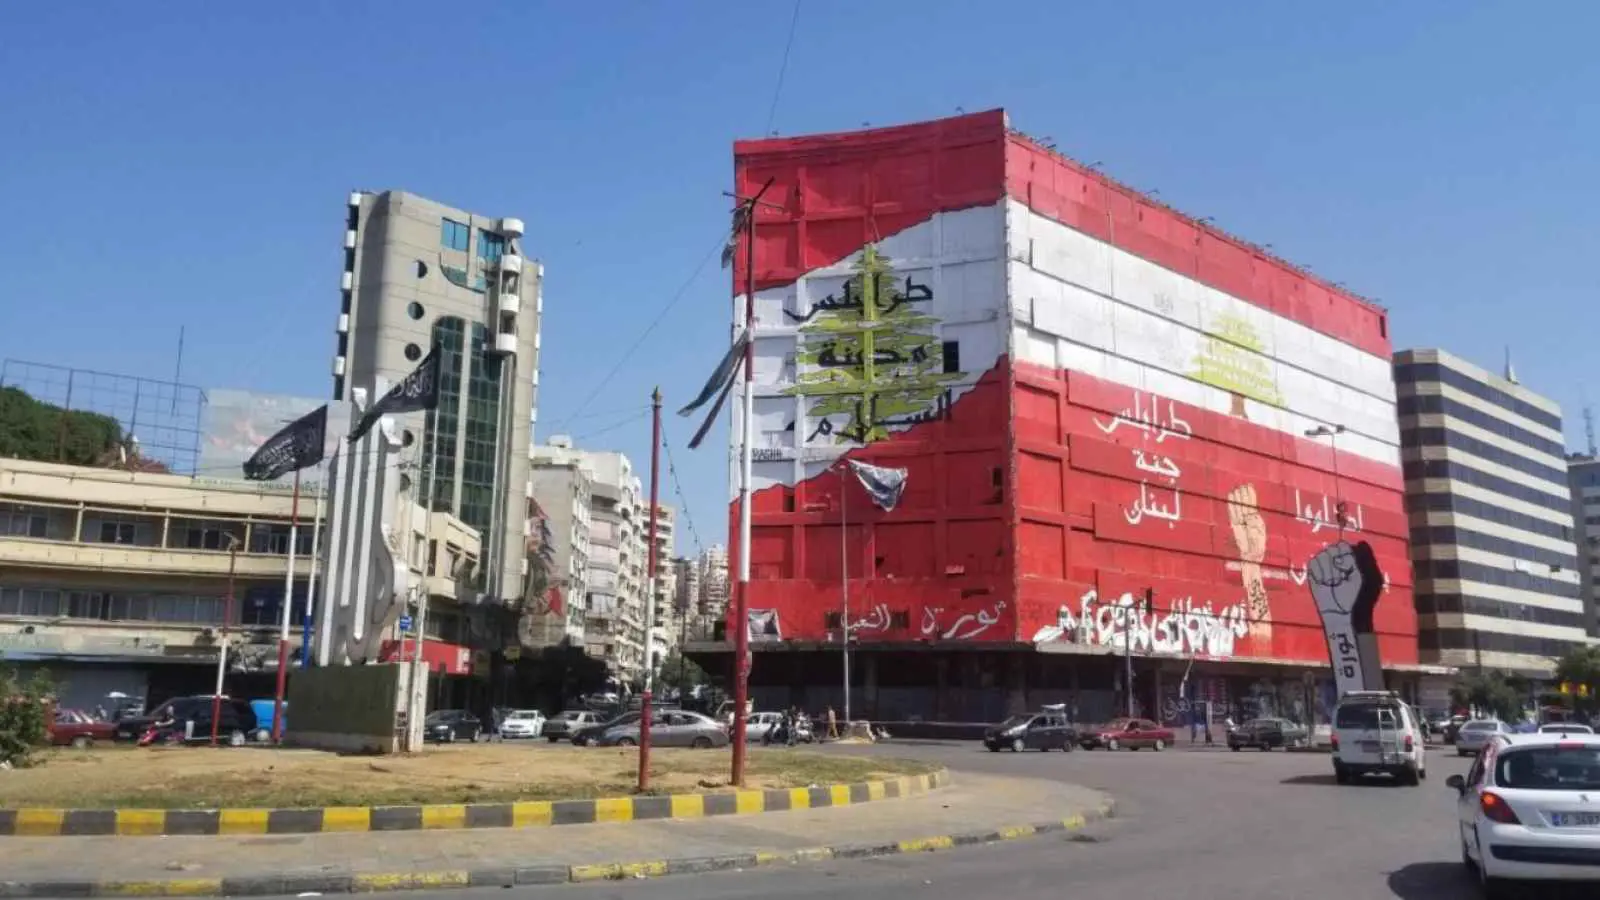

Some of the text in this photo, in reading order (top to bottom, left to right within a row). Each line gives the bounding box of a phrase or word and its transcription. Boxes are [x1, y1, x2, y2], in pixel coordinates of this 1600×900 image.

[783, 273, 934, 322] طرابلس
[818, 342, 928, 371] مدينة
[806, 387, 952, 443] السلام
[1092, 390, 1192, 442] طرابلس
[1132, 448, 1181, 483] جنة
[1124, 478, 1181, 529] لبنان
[921, 600, 1007, 639] ثورة
[1329, 632, 1357, 678] ثورة
